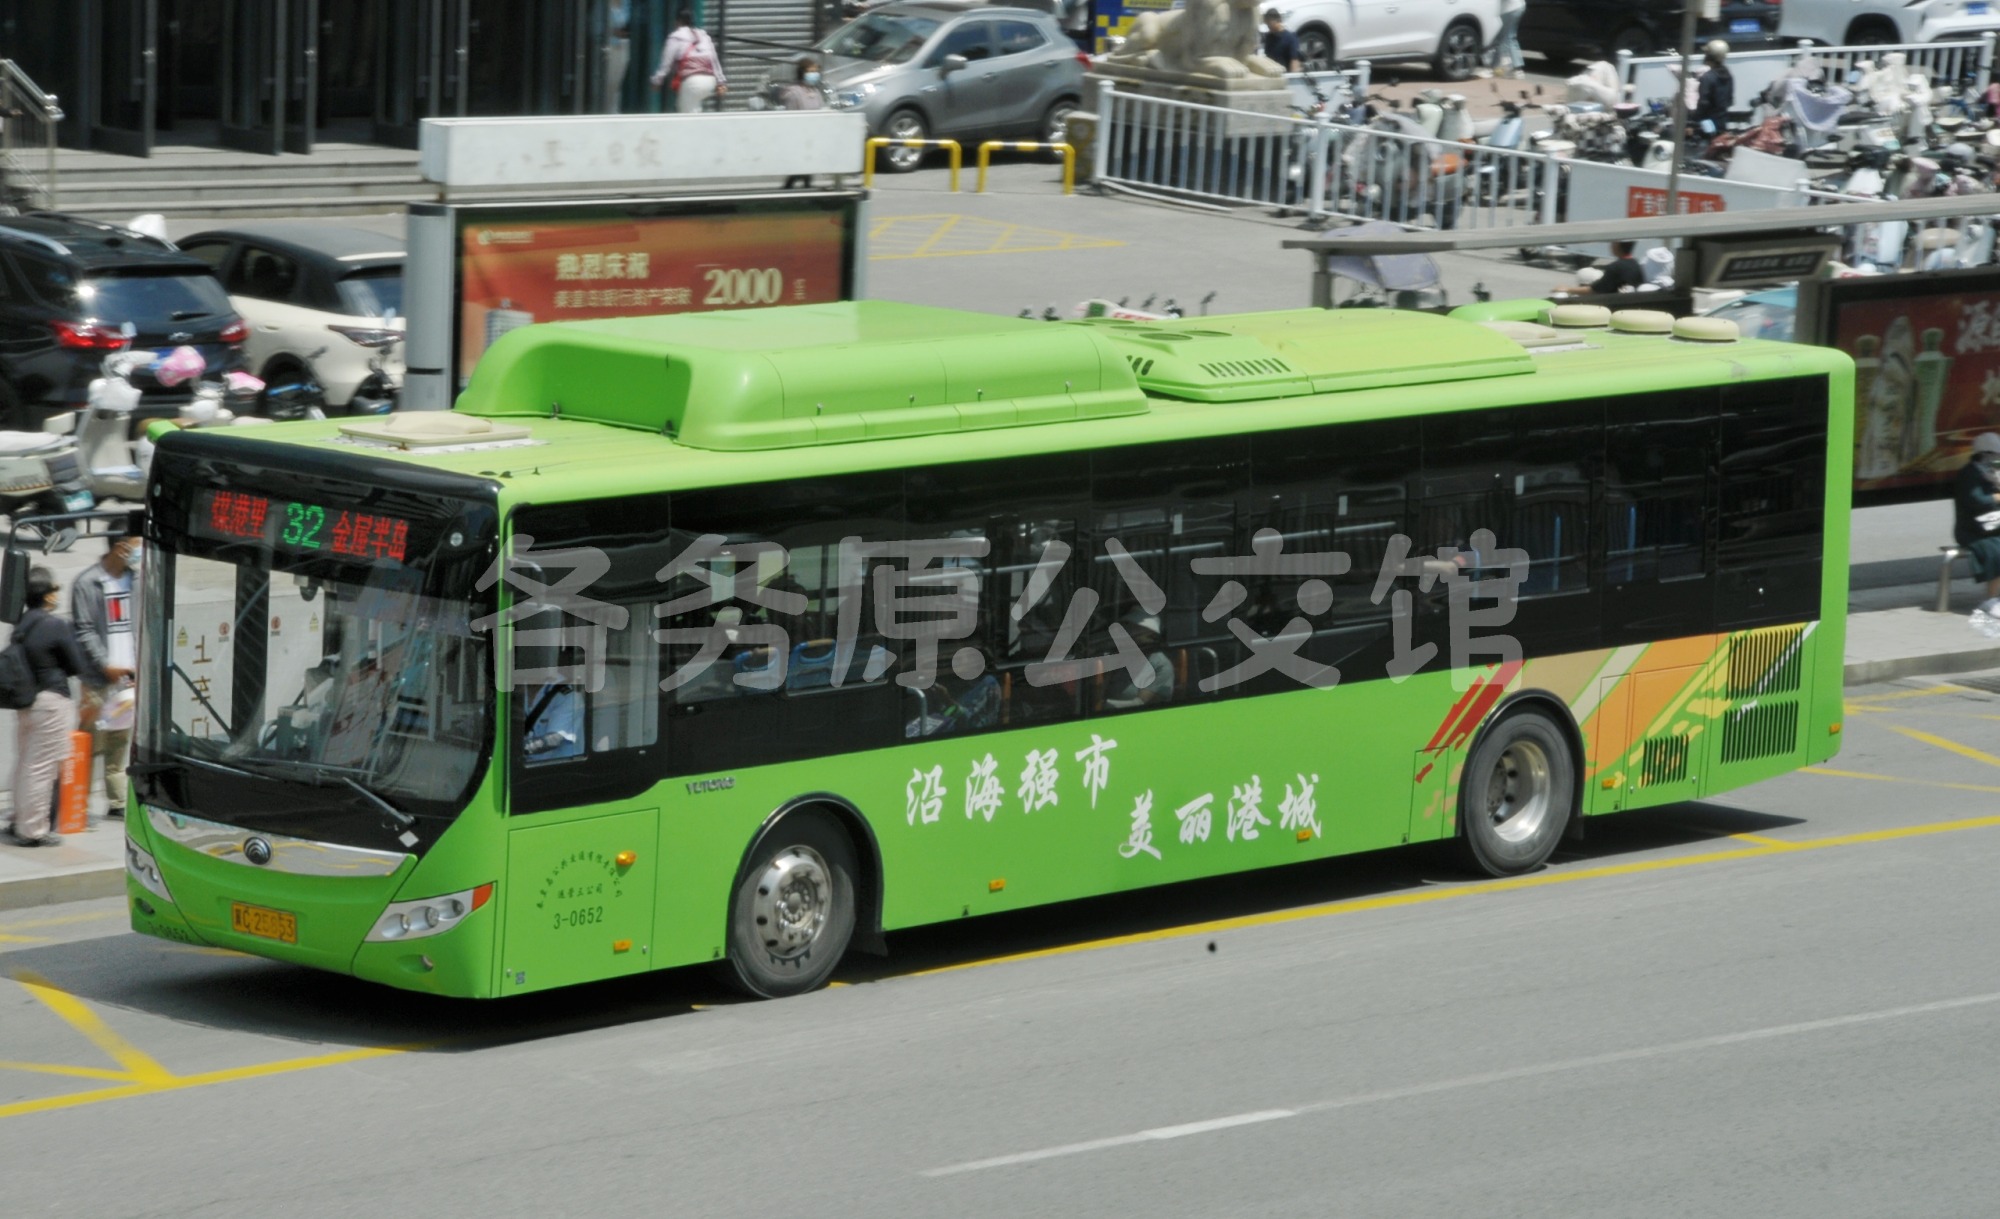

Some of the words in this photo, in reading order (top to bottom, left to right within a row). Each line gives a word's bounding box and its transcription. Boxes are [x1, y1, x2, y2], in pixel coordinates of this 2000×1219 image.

[556, 252, 649, 281] 热烈庆祝
[702, 267, 783, 305] 2000
[282, 502, 326, 549] 32
[331, 509, 409, 562] 金屋半岛
[906, 733, 1118, 826] 沿海强市
[1118, 774, 1322, 861] 美丽港城
[553, 905, 603, 930] 3-0652
